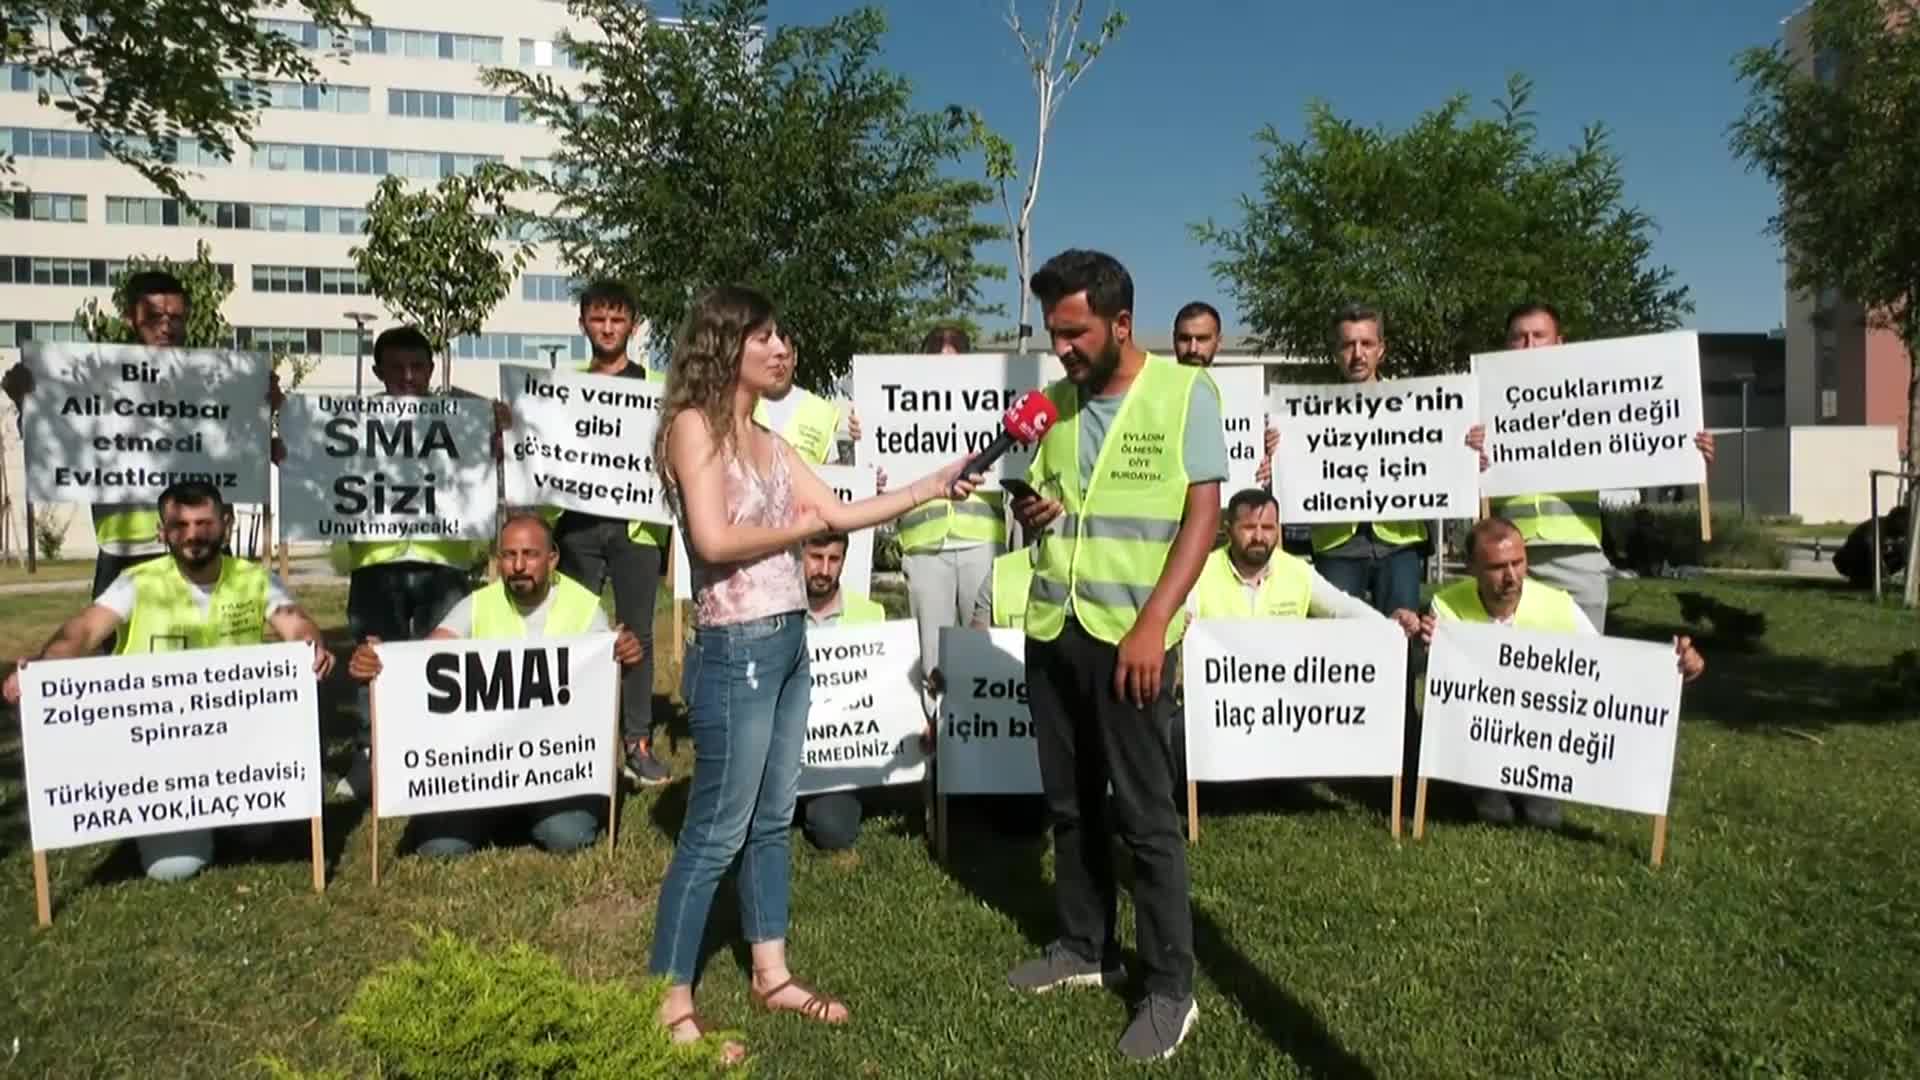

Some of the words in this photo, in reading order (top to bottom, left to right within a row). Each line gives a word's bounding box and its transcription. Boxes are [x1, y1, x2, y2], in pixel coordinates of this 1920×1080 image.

[121, 362, 160, 383] Bir
[318, 396, 458, 416] Uyutmayacak!
[881, 384, 952, 411] Tanı
[961, 388, 1017, 411] var
[1506, 374, 1664, 409] Çocuklarımız
[61, 395, 101, 416] Ali
[113, 399, 231, 420] Cabbar
[1495, 408, 1612, 434] kader'den
[1618, 398, 1680, 426] değil
[324, 418, 460, 459] SMA
[575, 415, 622, 438] gibi
[876, 422, 957, 453] tedavi
[1122, 432, 1166, 441] EVLADIM
[1307, 426, 1443, 452] yüzyılında
[93, 433, 203, 452] etmedi
[1120, 443, 1163, 455] ÖLMESİN
[1492, 438, 1602, 463] ihmalden
[1609, 431, 1688, 456] ölüyor
[1128, 457, 1150, 467] DİYE
[1322, 459, 1369, 483] ilaç
[1379, 456, 1427, 481] için
[333, 472, 437, 515] Sizi
[533, 473, 655, 505] vazgeçin!
[1303, 489, 1449, 514] dileniyoruz
[318, 519, 460, 537] Unutmayacak!
[809, 641, 886, 662] IYORUZ
[1499, 643, 1601, 682] Bebekler,
[41, 673, 146, 701] Düynada
[151, 669, 198, 688] sma
[203, 659, 298, 684] tedavisi;
[425, 647, 571, 714] SMA!
[1205, 655, 1286, 685] Dilene
[1293, 655, 1376, 684] dilene
[43, 701, 174, 725] Zolgensma
[190, 687, 299, 712] Risdiplam
[1215, 698, 1255, 735] ilaç
[1262, 698, 1366, 732] alıyoruz
[1430, 677, 1515, 705] uyurken
[1521, 690, 1587, 716] sessiz
[1593, 694, 1669, 726] olunur
[130, 720, 229, 746] Spinraza
[948, 713, 998, 743] için
[1470, 716, 1552, 752] ölürken
[1558, 728, 1616, 764] değil
[404, 750, 420, 769] O
[425, 744, 514, 768] Senindir
[519, 740, 534, 758] O
[539, 734, 596, 757] Senin
[44, 775, 160, 807] Türkiyede
[165, 772, 210, 792] sma
[216, 760, 306, 787] tedavisi;
[408, 772, 520, 798] Milletindir
[524, 761, 594, 787] Ancak!
[1500, 764, 1574, 794] suSma
[73, 809, 133, 832] PARA
[244, 790, 287, 812] YOK
